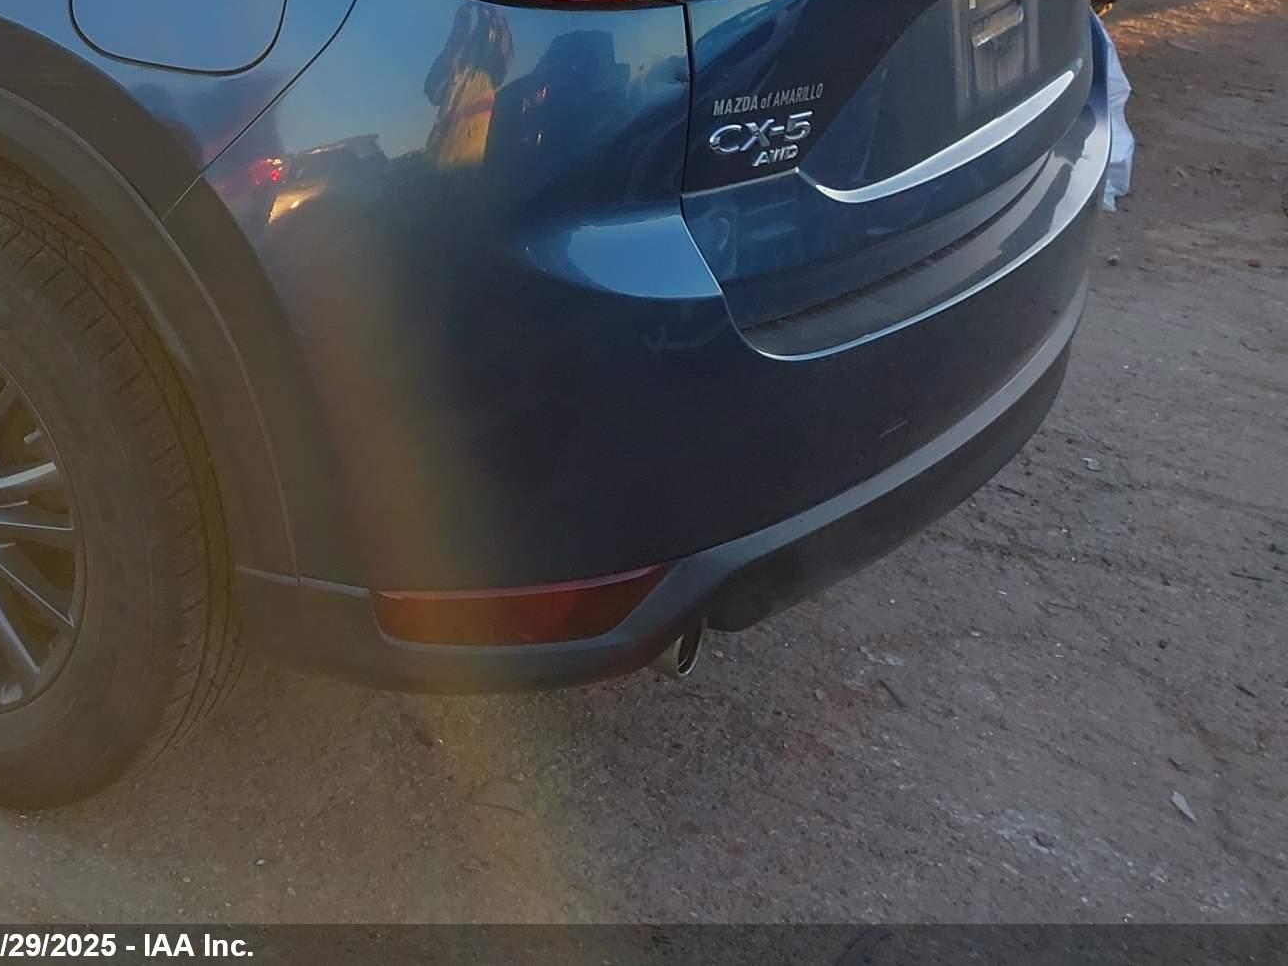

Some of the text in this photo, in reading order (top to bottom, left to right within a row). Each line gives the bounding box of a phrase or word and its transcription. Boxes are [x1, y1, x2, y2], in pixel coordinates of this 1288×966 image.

[712, 83, 824, 116] MAZDA of AMARILLO
[709, 111, 813, 155] CX-5
[751, 144, 799, 167] AWD
